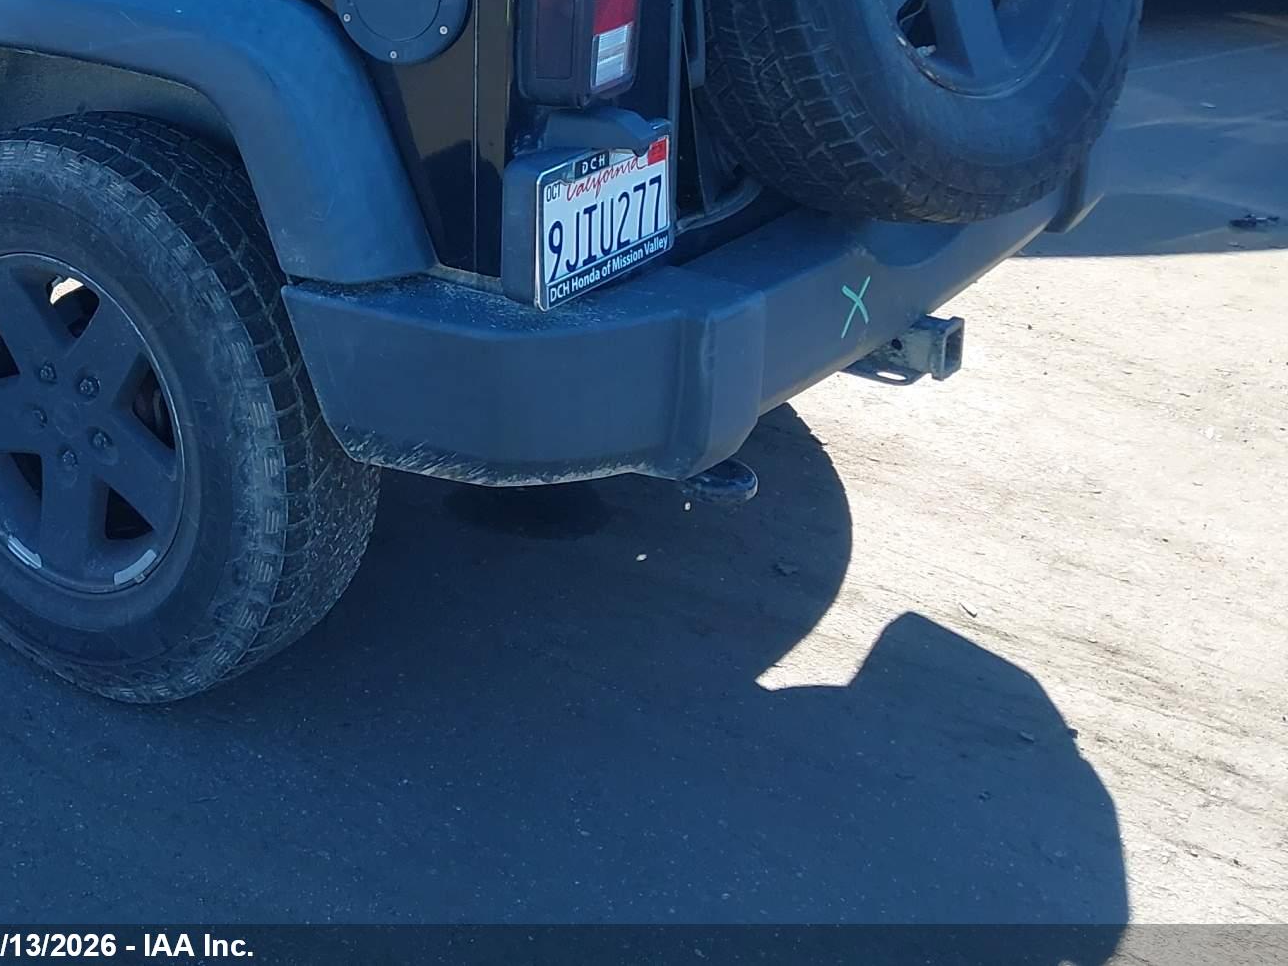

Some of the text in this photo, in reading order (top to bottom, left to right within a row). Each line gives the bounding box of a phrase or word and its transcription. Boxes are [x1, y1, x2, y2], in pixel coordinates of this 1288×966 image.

[580, 155, 607, 175] DCH
[547, 174, 663, 283] 9JIU277
[549, 234, 669, 303] DCH Honda of Mission Valley
